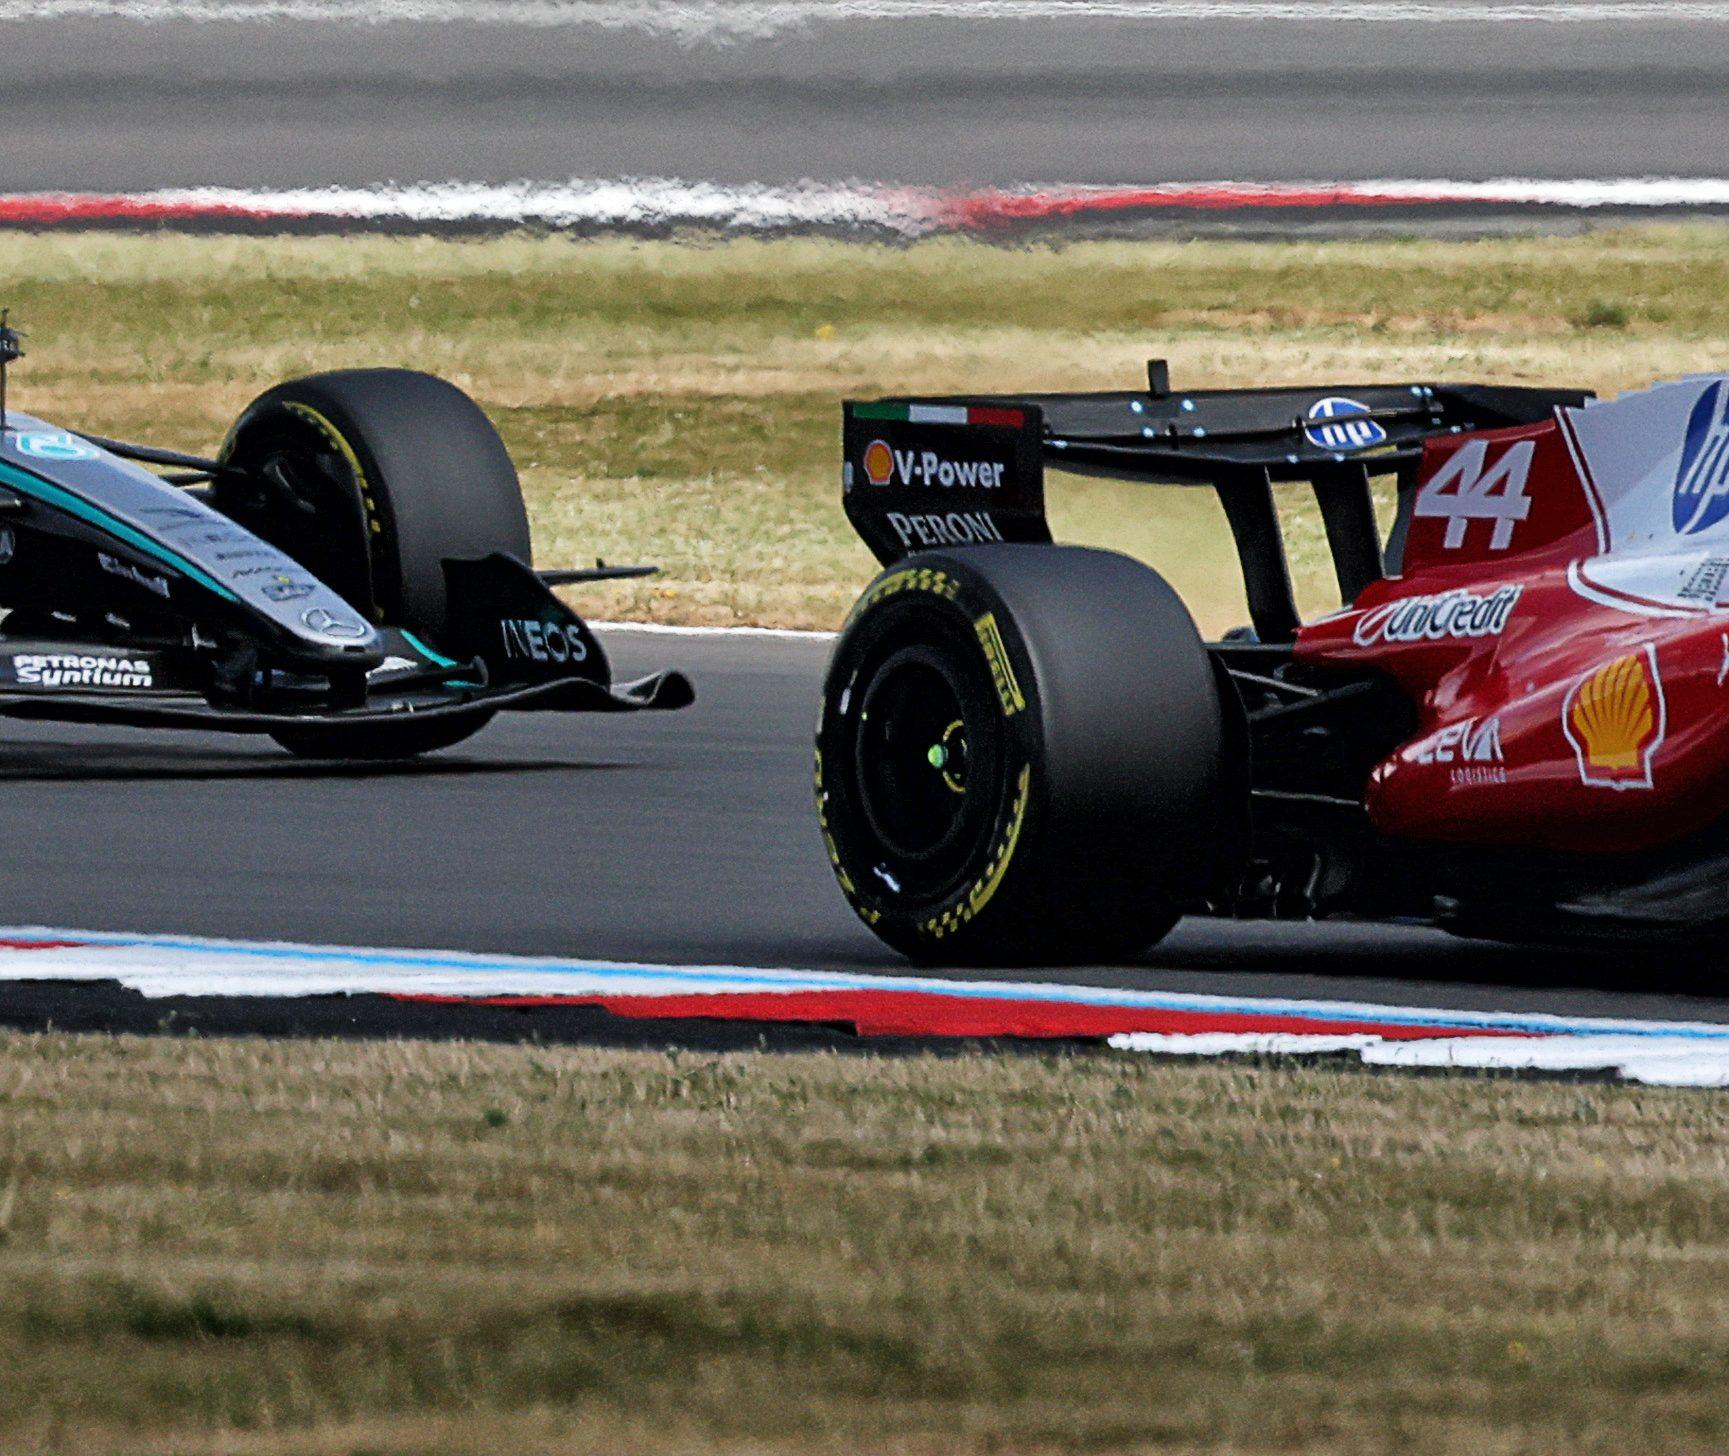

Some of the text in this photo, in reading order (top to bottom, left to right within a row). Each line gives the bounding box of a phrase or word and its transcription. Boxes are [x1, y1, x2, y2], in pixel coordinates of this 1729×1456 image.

[895, 450, 1005, 489] V-Power
[1414, 440, 1537, 550] 44
[887, 512, 1004, 546] PERONI
[1385, 583, 1523, 640] UniCredit
[501, 618, 588, 663] INEOS
[14, 655, 151, 673] PETRONAS
[16, 667, 153, 687] Syntium
